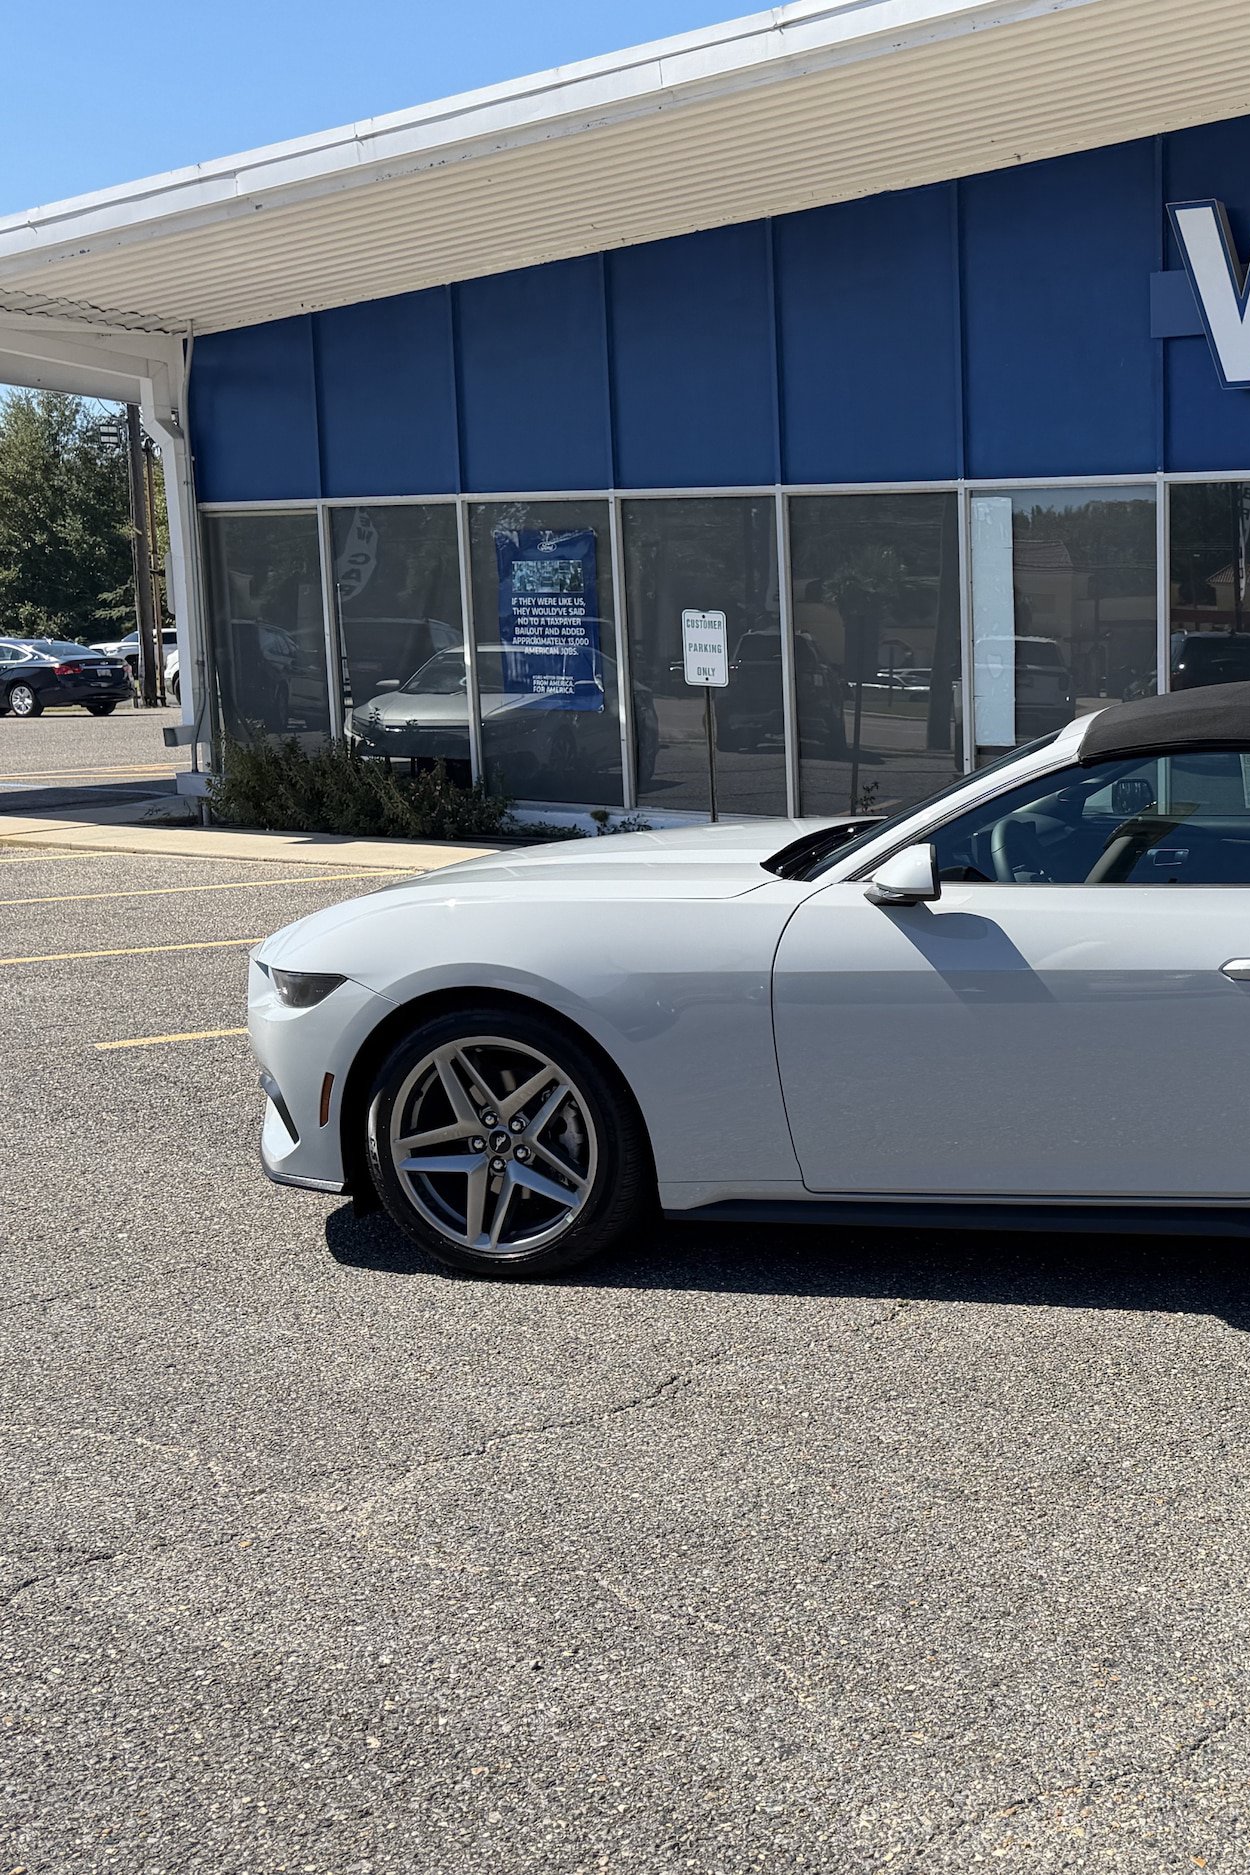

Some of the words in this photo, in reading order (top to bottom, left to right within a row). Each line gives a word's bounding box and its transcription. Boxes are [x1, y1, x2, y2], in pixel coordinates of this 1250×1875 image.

[511, 598, 518, 606] IF
[519, 598, 537, 606] THEY
[537, 598, 556, 606] WERE
[558, 598, 573, 606] LIKE
[573, 598, 586, 607] US,
[512, 607, 530, 616] THEY
[531, 607, 567, 616] WOULD'VE
[568, 607, 585, 616] SAID
[517, 618, 529, 626] NO
[530, 618, 539, 626] TO
[540, 618, 546, 626] A
[547, 618, 581, 626] TAXPAYER
[686, 619, 722, 630] CUSTOMER
[514, 627, 543, 635] BAILOUT
[544, 627, 560, 636] AND
[561, 627, 585, 636] ADDED
[512, 636, 566, 645] APPROXIMATELY
[524, 646, 559, 655] AMERICAN
[560, 647, 579, 656] JOBS.
[688, 643, 723, 654] PARKING
[696, 666, 716, 677] ONLY
